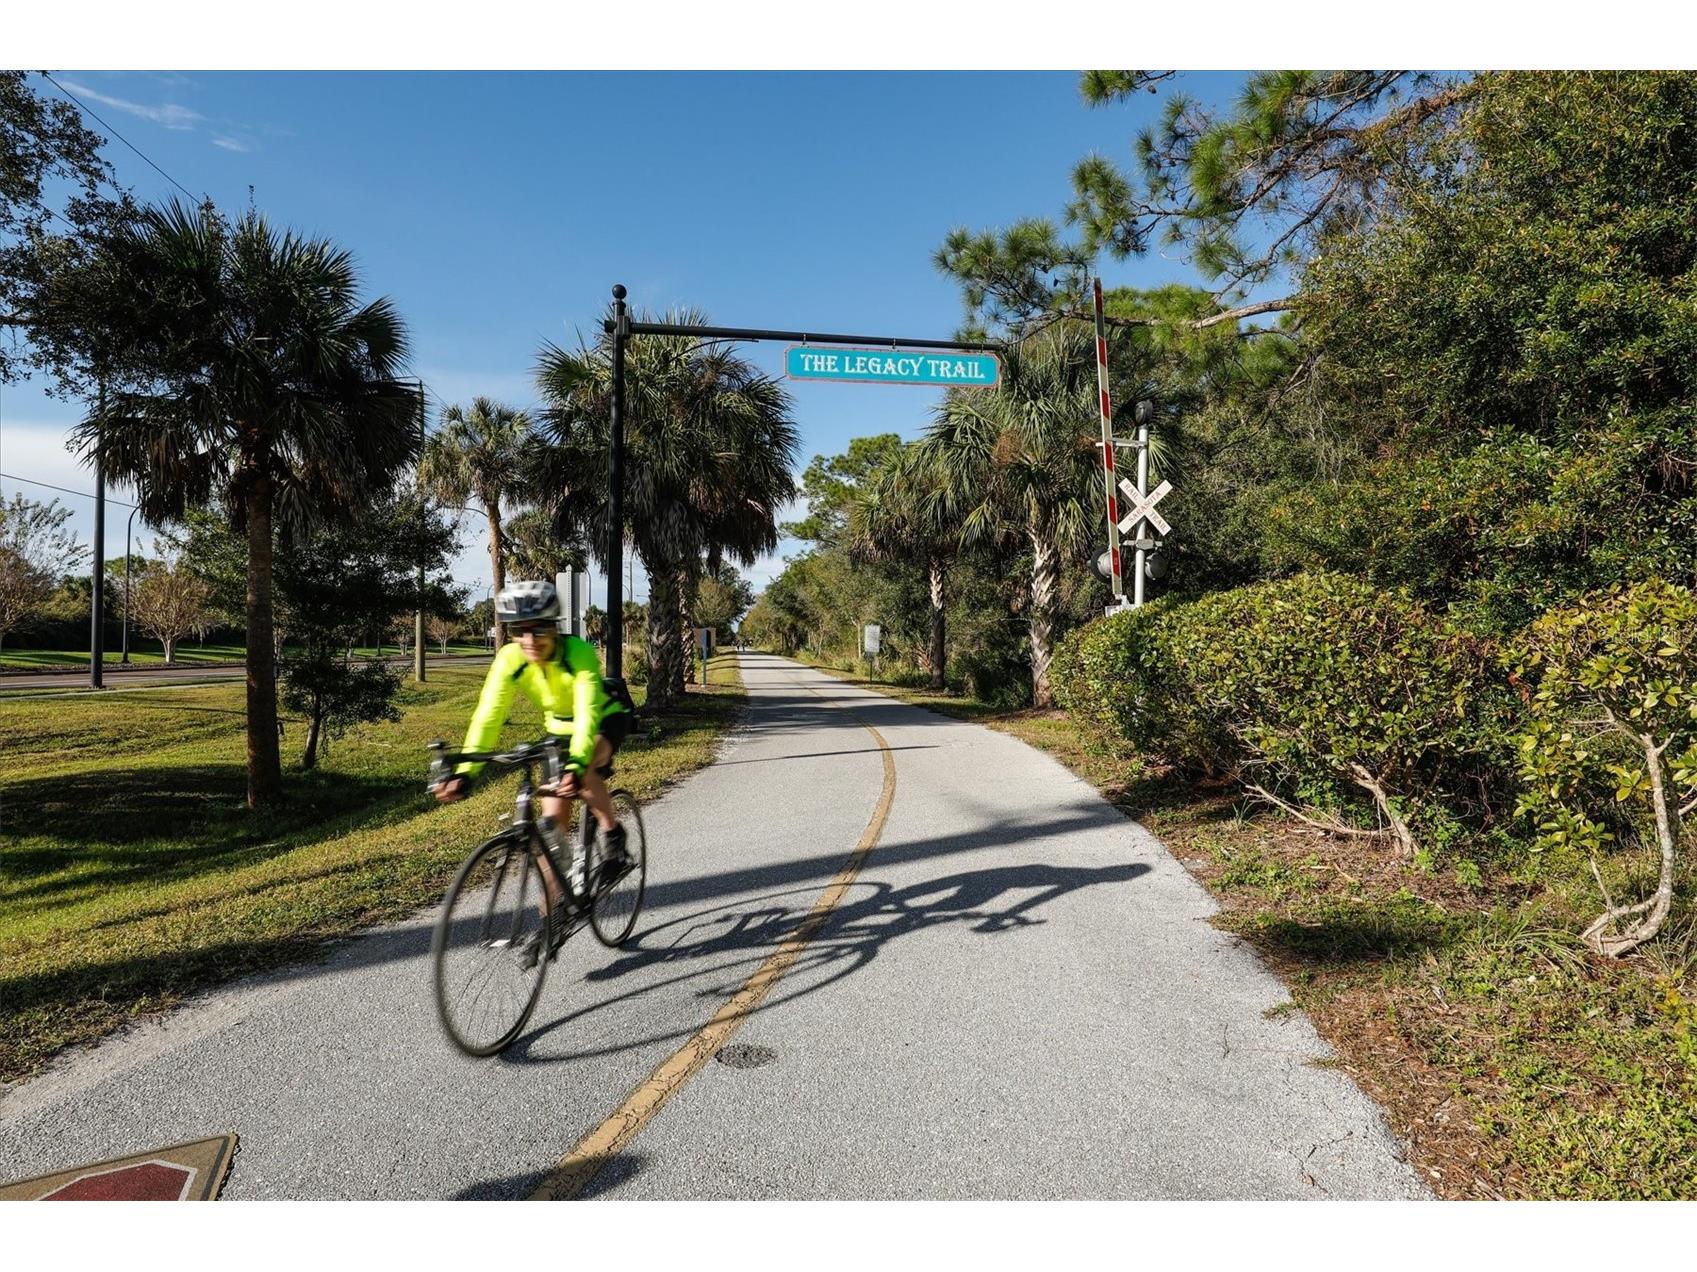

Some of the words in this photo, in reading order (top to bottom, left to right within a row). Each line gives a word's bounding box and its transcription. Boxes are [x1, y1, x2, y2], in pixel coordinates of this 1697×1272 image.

[800, 354, 839, 373] THE
[844, 356, 925, 376] LEGACY
[927, 359, 985, 379] TRAIL
[1124, 483, 1138, 500] RAIL
[1128, 491, 1162, 523] SARASOTA
[1150, 511, 1167, 532] TRAIL
